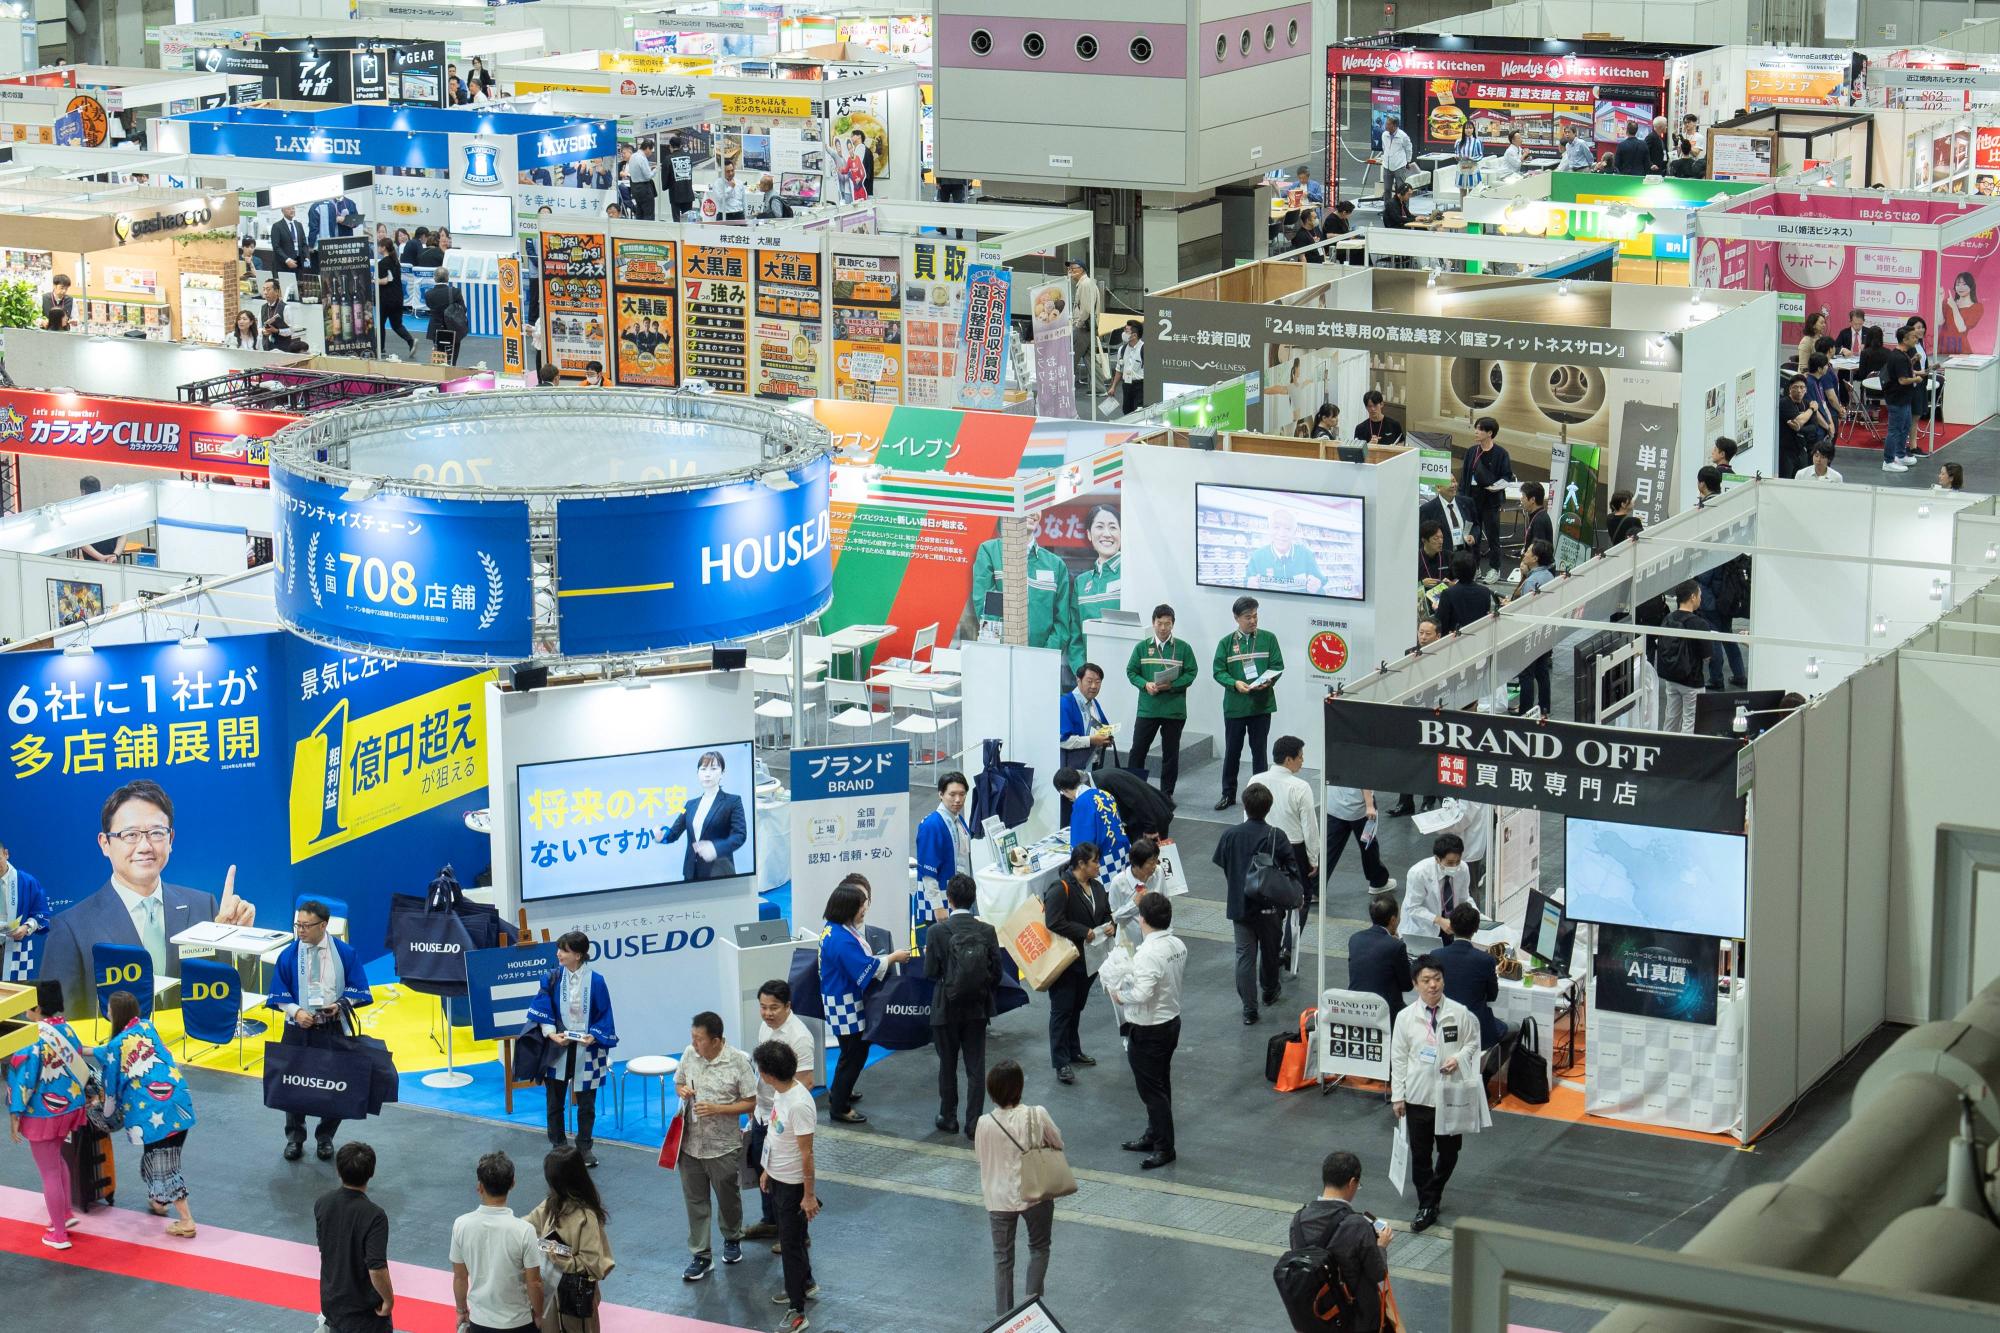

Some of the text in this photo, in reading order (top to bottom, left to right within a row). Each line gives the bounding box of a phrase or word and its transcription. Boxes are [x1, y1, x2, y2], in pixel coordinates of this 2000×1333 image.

[299, 61, 332, 79] アイ
[1342, 53, 1485, 72] Wendy's First Kitchen
[1501, 58, 1649, 79] Wendy's First Kitchen
[298, 78, 333, 96] サポ
[1750, 80, 1809, 92] フーシェア
[1906, 74, 1977, 84] 近江焼肉ホルモンすだく
[638, 84, 696, 98] ちゃんぽん亭
[1477, 85, 1590, 102] 5年間 運営支援金 支給!
[734, 97, 787, 106] 近江ちゃんぽんを
[275, 135, 361, 156] LAWSON
[465, 147, 497, 155] LAWSON
[537, 133, 598, 158] LAWSON
[131, 208, 211, 238] gashacoco
[1498, 205, 1656, 240] SUBW
[1859, 209, 1920, 221] IBJならではの
[719, 234, 781, 247] 株式会社 大黒屋
[699, 245, 729, 256] チケット
[776, 253, 801, 262] チケット
[980, 252, 1001, 260] FC063
[1863, 253, 1898, 264] 働く場所も
[686, 256, 743, 278] 大黒屋
[914, 243, 967, 281] 買取
[1785, 253, 1838, 270] サポート
[1876, 264, 1913, 274] 時間も自由
[763, 261, 812, 282] 大黒屋
[685, 281, 746, 304] 7つの強み
[622, 297, 668, 317] 大黒屋
[968, 284, 990, 342] 遺品整理
[1779, 303, 1803, 312] FC064
[983, 287, 1005, 382] 不用品回収・買取
[1158, 318, 1252, 348] 2年半で投資回収
[1161, 358, 1191, 368] HITORI
[29, 419, 182, 446] カラオケCLUB
[129, 443, 179, 453] カラオケクラブダム
[1421, 462, 1449, 475] FC051
[1652, 448, 1669, 523] 直営店初月から
[701, 506, 831, 586] HOUSED
[324, 551, 477, 612] 全国 708 店舗
[7, 664, 260, 725] 6社に1社が
[8, 714, 262, 781] 多店舗展開
[348, 702, 478, 798] 億円超え
[1418, 719, 1661, 773] BRAND OFF
[808, 752, 894, 779] ブランド
[1440, 755, 1465, 770] 高価
[324, 745, 342, 810] 粗利益
[420, 755, 477, 797] が狙える
[1440, 770, 1465, 786] 買取
[1475, 762, 1639, 807] 買取専門店
[828, 779, 875, 793] BRAND
[528, 784, 688, 832] 将来の不安
[857, 807, 876, 818] 全国
[816, 825, 836, 835] 上場
[857, 819, 876, 829] 展開
[808, 846, 893, 865] 認知・信頼・安心
[588, 925, 715, 966] OUSEDO
[1017, 925, 1049, 963] BURGER KING
[1626, 960, 1687, 985] AI真贋
[1327, 998, 1381, 1011] BRAND OFF
